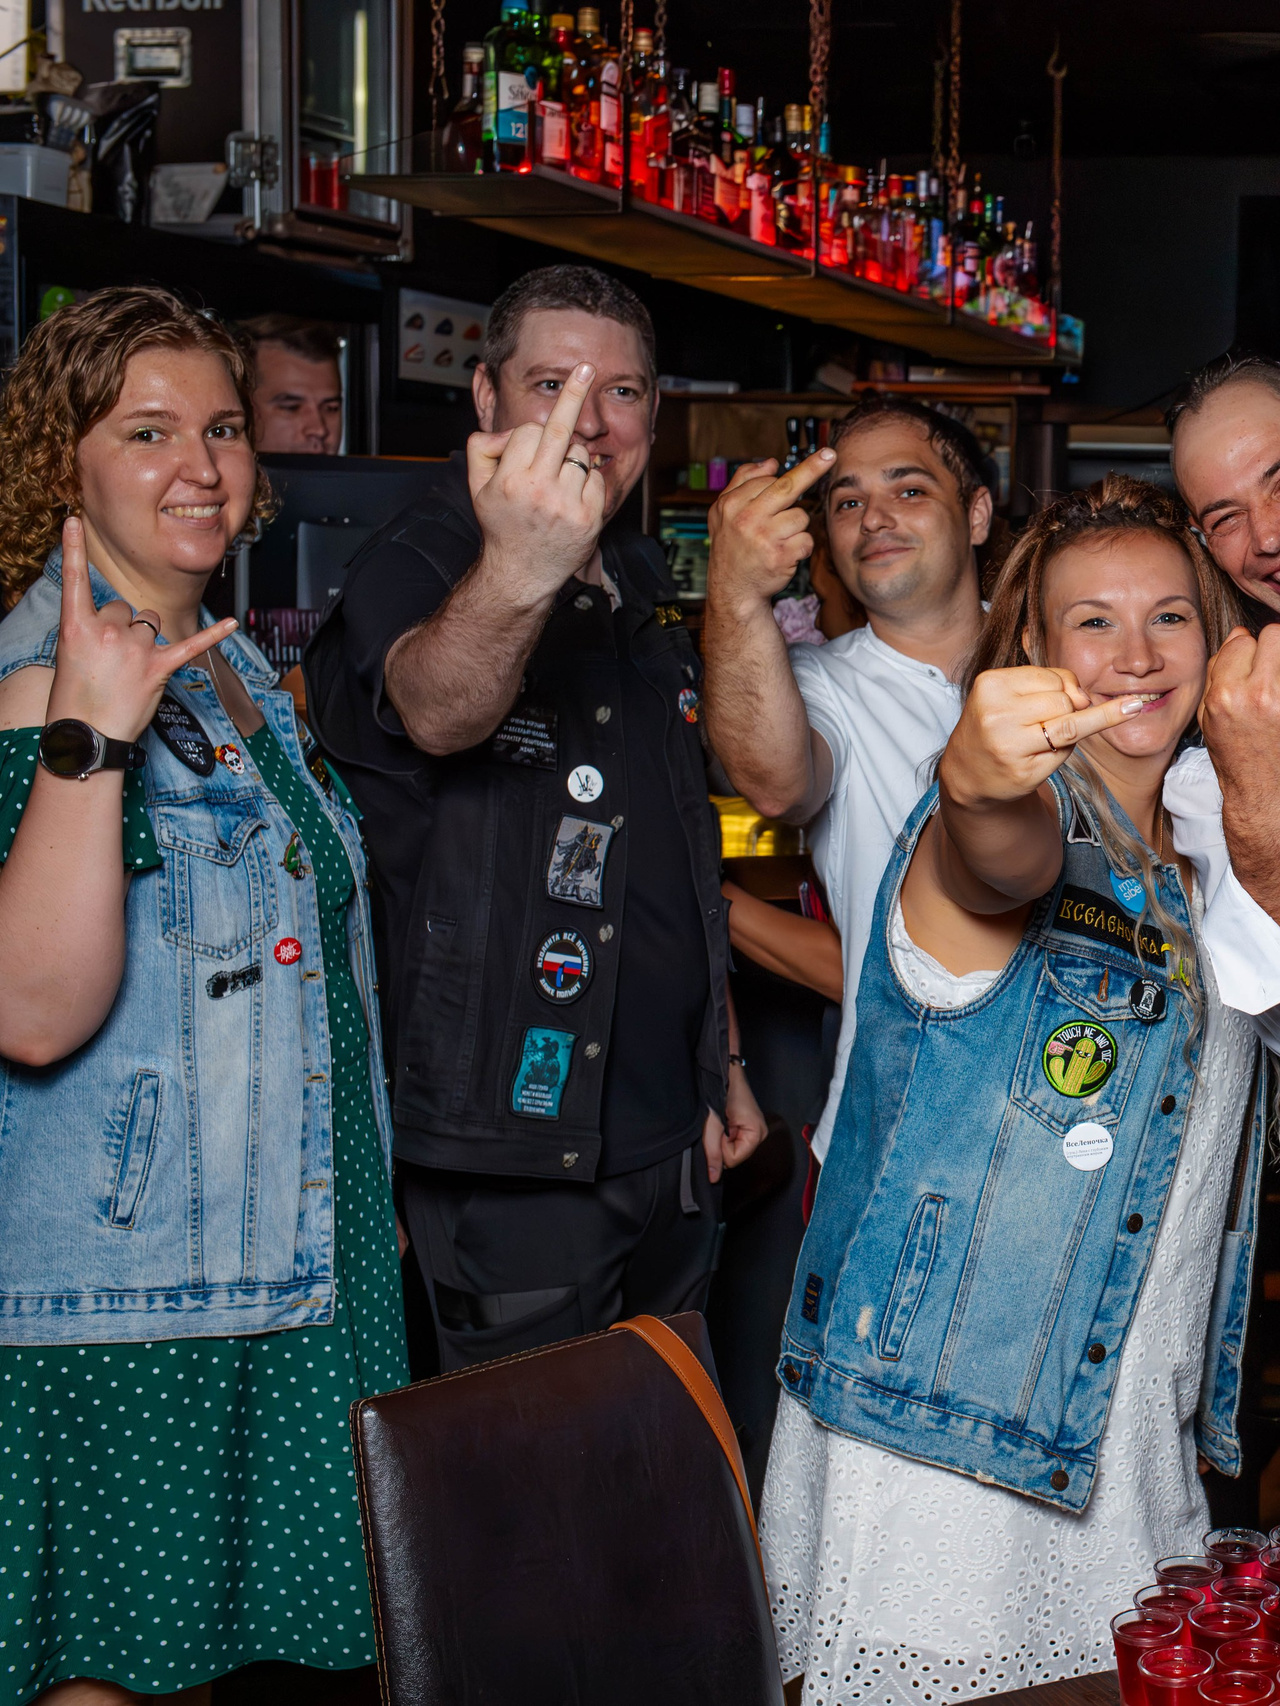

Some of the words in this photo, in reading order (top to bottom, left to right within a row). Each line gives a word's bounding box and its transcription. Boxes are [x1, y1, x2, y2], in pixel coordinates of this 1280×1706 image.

[536, 932, 561, 968] ИЗОЛЕНТА
[556, 981, 581, 998] ПОЛЬШУ
[1056, 1025, 1081, 1044] TOUCH
[1083, 1026, 1096, 1039] ME
[1093, 1033, 1110, 1049] AND
[1101, 1049, 1112, 1064] DIE
[1065, 1138, 1109, 1148] ВсеЛеночка
